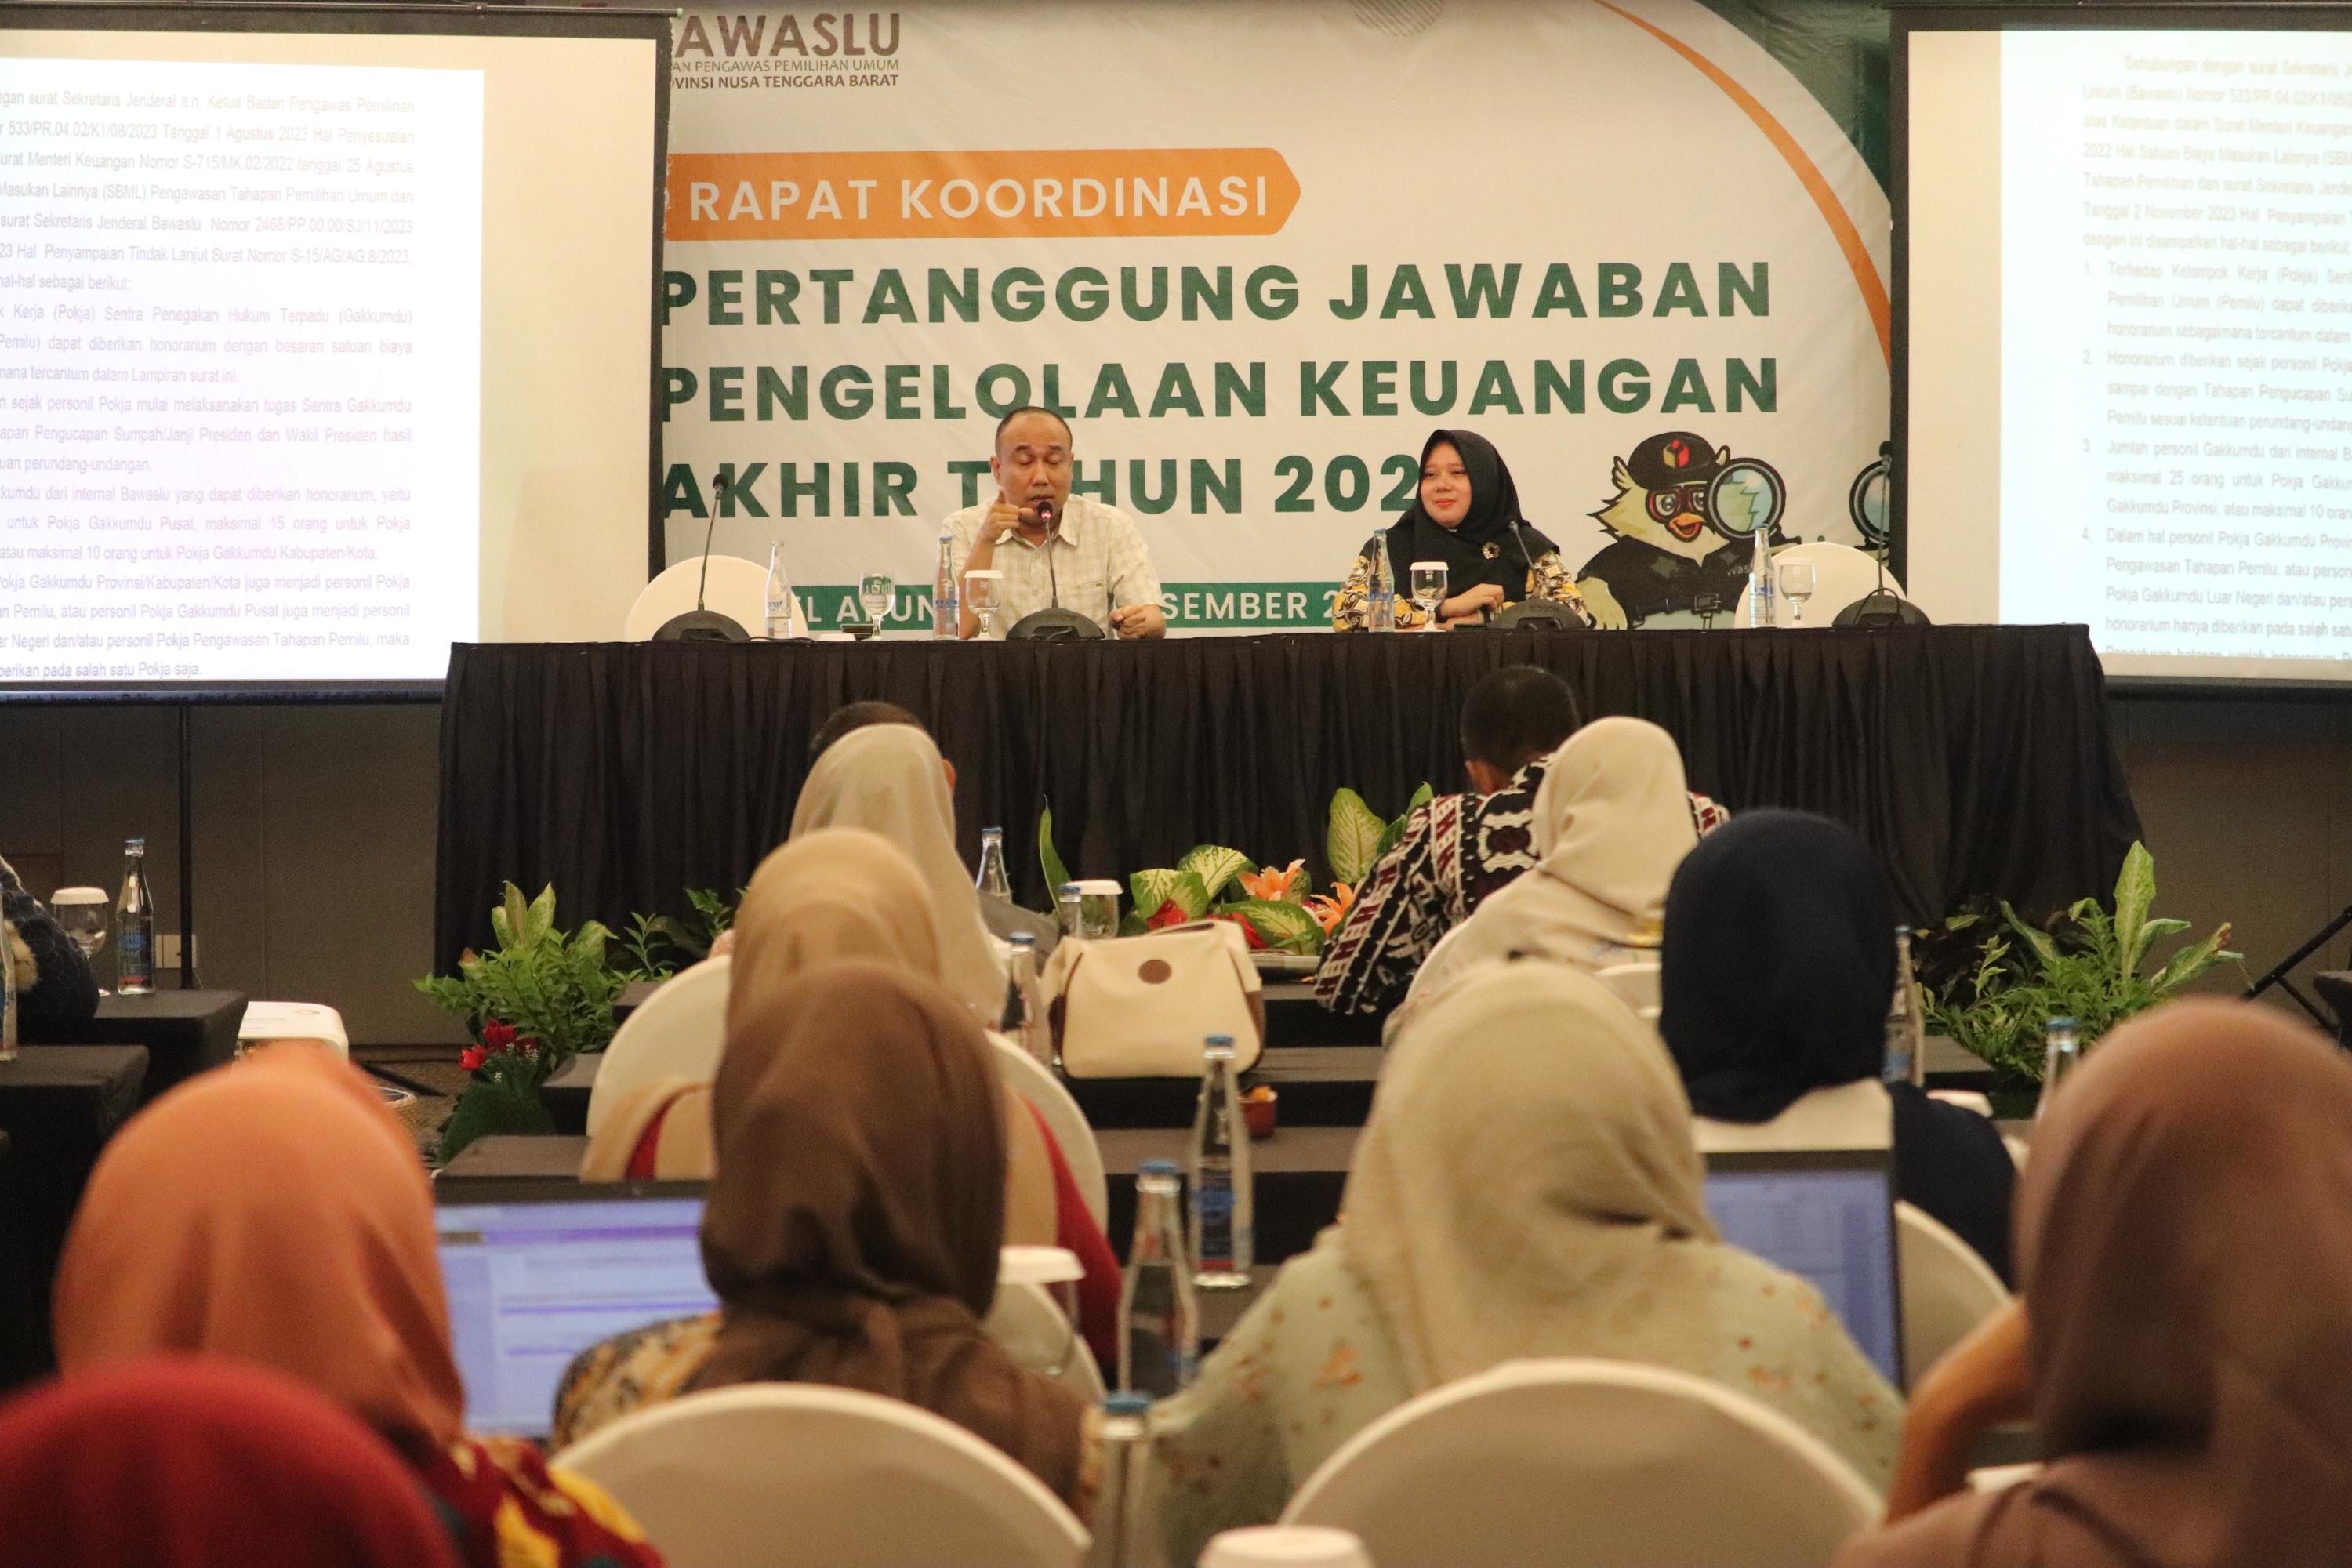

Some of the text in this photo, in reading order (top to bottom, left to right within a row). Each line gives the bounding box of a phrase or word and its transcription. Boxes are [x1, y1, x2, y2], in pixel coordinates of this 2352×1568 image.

[674, 13, 899, 57] AWASLU
[673, 59, 899, 72] AN PENGAWAS PEMILIHAN UMUM
[672, 74, 899, 89] VINSI NUSA TENGGARA BARAT
[164, 124, 210, 143] Tanggal
[216, 125, 220, 140] 1
[225, 125, 275, 144] Agustus
[278, 126, 309, 141] 2023
[312, 127, 333, 142] Hal
[337, 128, 415, 147] Penyesuaian
[52, 183, 100, 201] Lainnya
[102, 183, 147, 202] (SBML)
[150, 184, 227, 203] Pengawasan
[230, 186, 282, 205] Tahapan
[285, 187, 345, 201] Pemilihan
[347, 187, 388, 202] Umum
[390, 188, 414, 203] dan
[691, 176, 1266, 222] RAPAT KOORDINASI
[0, 214, 31, 228] surat
[34, 213, 93, 229] Sekretaris
[96, 215, 147, 230] Jenderal
[151, 216, 201, 230] Bawaslu
[210, 216, 251, 231] Nomor
[16, 243, 37, 259] Hal
[44, 244, 125, 263] Penyampaian
[128, 245, 169, 260] Tindak
[171, 246, 209, 265] Lanjut
[211, 246, 245, 262] Surat
[247, 247, 288, 263] Nomor
[38, 274, 85, 293] sebagai
[87, 275, 131, 290] berikut:
[662, 261, 1769, 326] PERTANGGUNG JAWABAN
[47, 335, 82, 354] dapat
[88, 336, 143, 351] diberikan
[149, 336, 217, 352] honorarium
[223, 337, 268, 356] dengan
[275, 338, 325, 354] besaran
[331, 340, 372, 354] satuan
[379, 339, 412, 358] biaya
[662, 358, 1777, 422] PENGELOLAAN KEUANGAN
[11, 395, 412, 416] sejak personil Pokja mulai melaksanakan tugas Sentra Gakkumdu
[34, 426, 108, 445] Pengucapan
[114, 426, 194, 445] Sumpah/Janji
[199, 426, 252, 441] Presiden
[257, 426, 280, 441] dan
[285, 426, 319, 442] Wakil
[325, 427, 377, 442] Presiden
[383, 427, 412, 442] hasil
[664, 454, 1419, 519] AKHIR THUN 202
[6, 515, 412, 534] untuk Pokja Gakkumdu Pusat, maksimal 15 orang untuk Pokja
[29, 574, 93, 590] Gakkumdu
[245, 575, 270, 593] juga
[274, 574, 321, 593] menjadi
[325, 574, 372, 593] personil
[376, 574, 411, 593] Pokja
[1162, 593, 1307, 619] SEMBER
[11, 633, 50, 652] Negeri
[53, 633, 104, 648] dan/atau
[107, 633, 154, 652] personil
[156, 633, 191, 651] Pokja
[193, 632, 270, 651] Pengawasan
[273, 632, 326, 650] Tahapan
[328, 631, 373, 648] Pemilu,
[376, 631, 410, 646] maka
[43, 663, 72, 682] pada
[75, 663, 107, 678] salah
[110, 664, 135, 678] satu
[138, 662, 171, 681] Pokja
[174, 663, 202, 681] saja.
